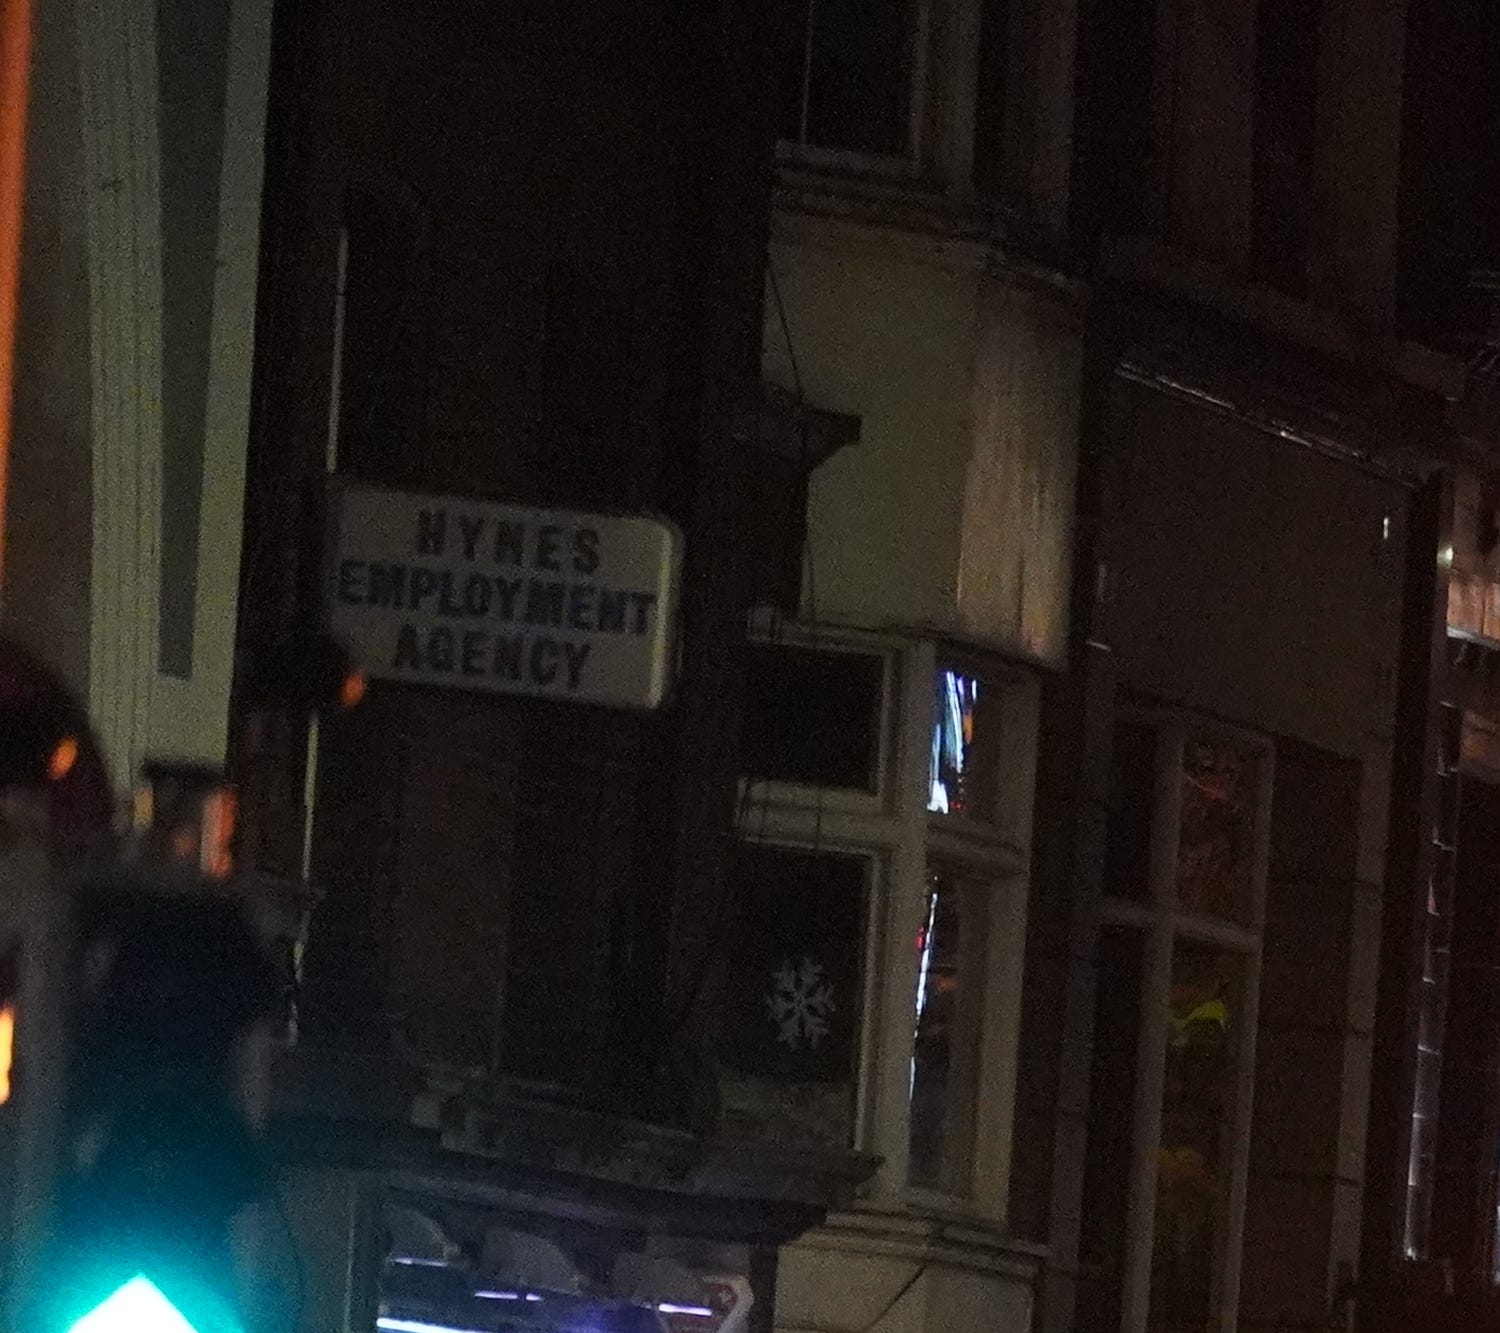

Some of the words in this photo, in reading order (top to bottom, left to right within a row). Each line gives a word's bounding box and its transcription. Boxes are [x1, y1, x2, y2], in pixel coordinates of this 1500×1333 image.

[415, 509, 600, 574] HYNES
[339, 560, 656, 635] EMPLOYMENT
[394, 623, 592, 689] AGENCY
